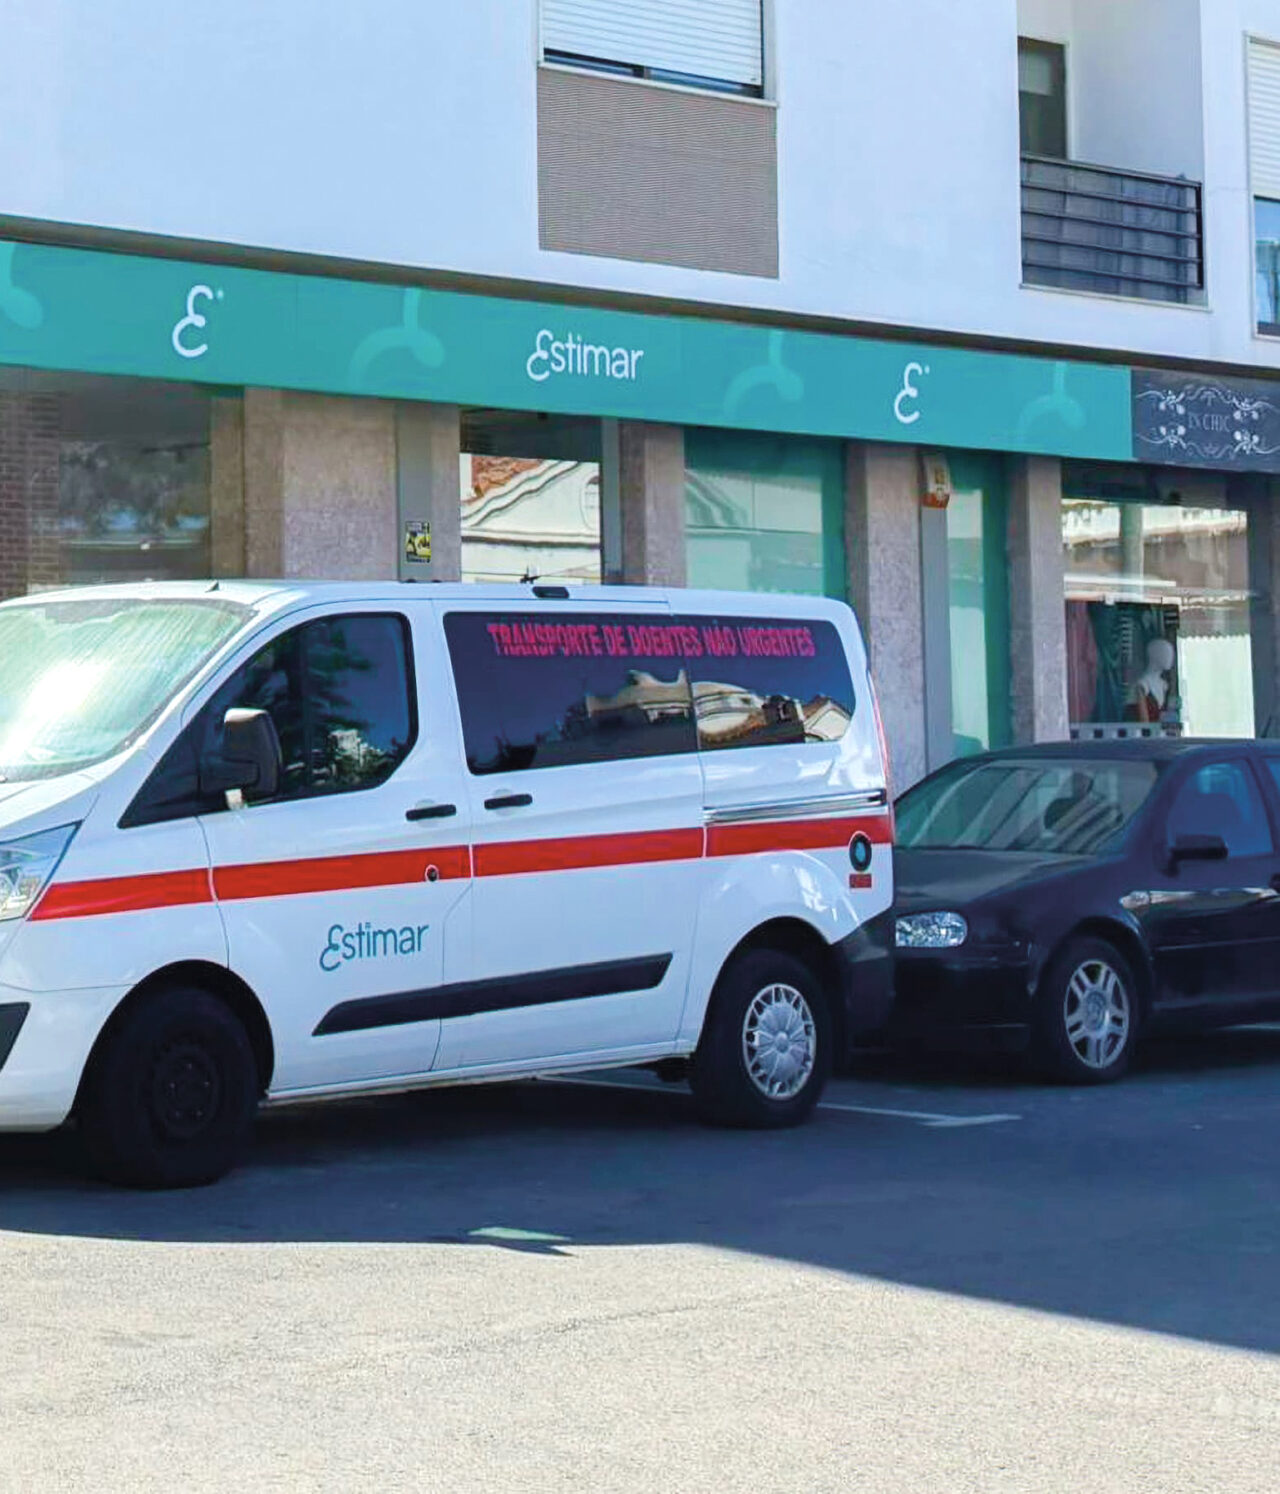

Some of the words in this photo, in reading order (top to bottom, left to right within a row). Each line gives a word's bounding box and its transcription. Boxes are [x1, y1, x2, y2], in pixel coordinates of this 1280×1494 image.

[526, 328, 645, 382] Estimar
[486, 623, 603, 657] TRANSPORTE
[601, 624, 628, 657] DE
[626, 625, 704, 657] DOENTES
[736, 625, 817, 658] URGENTES
[319, 921, 430, 972] Estimar
